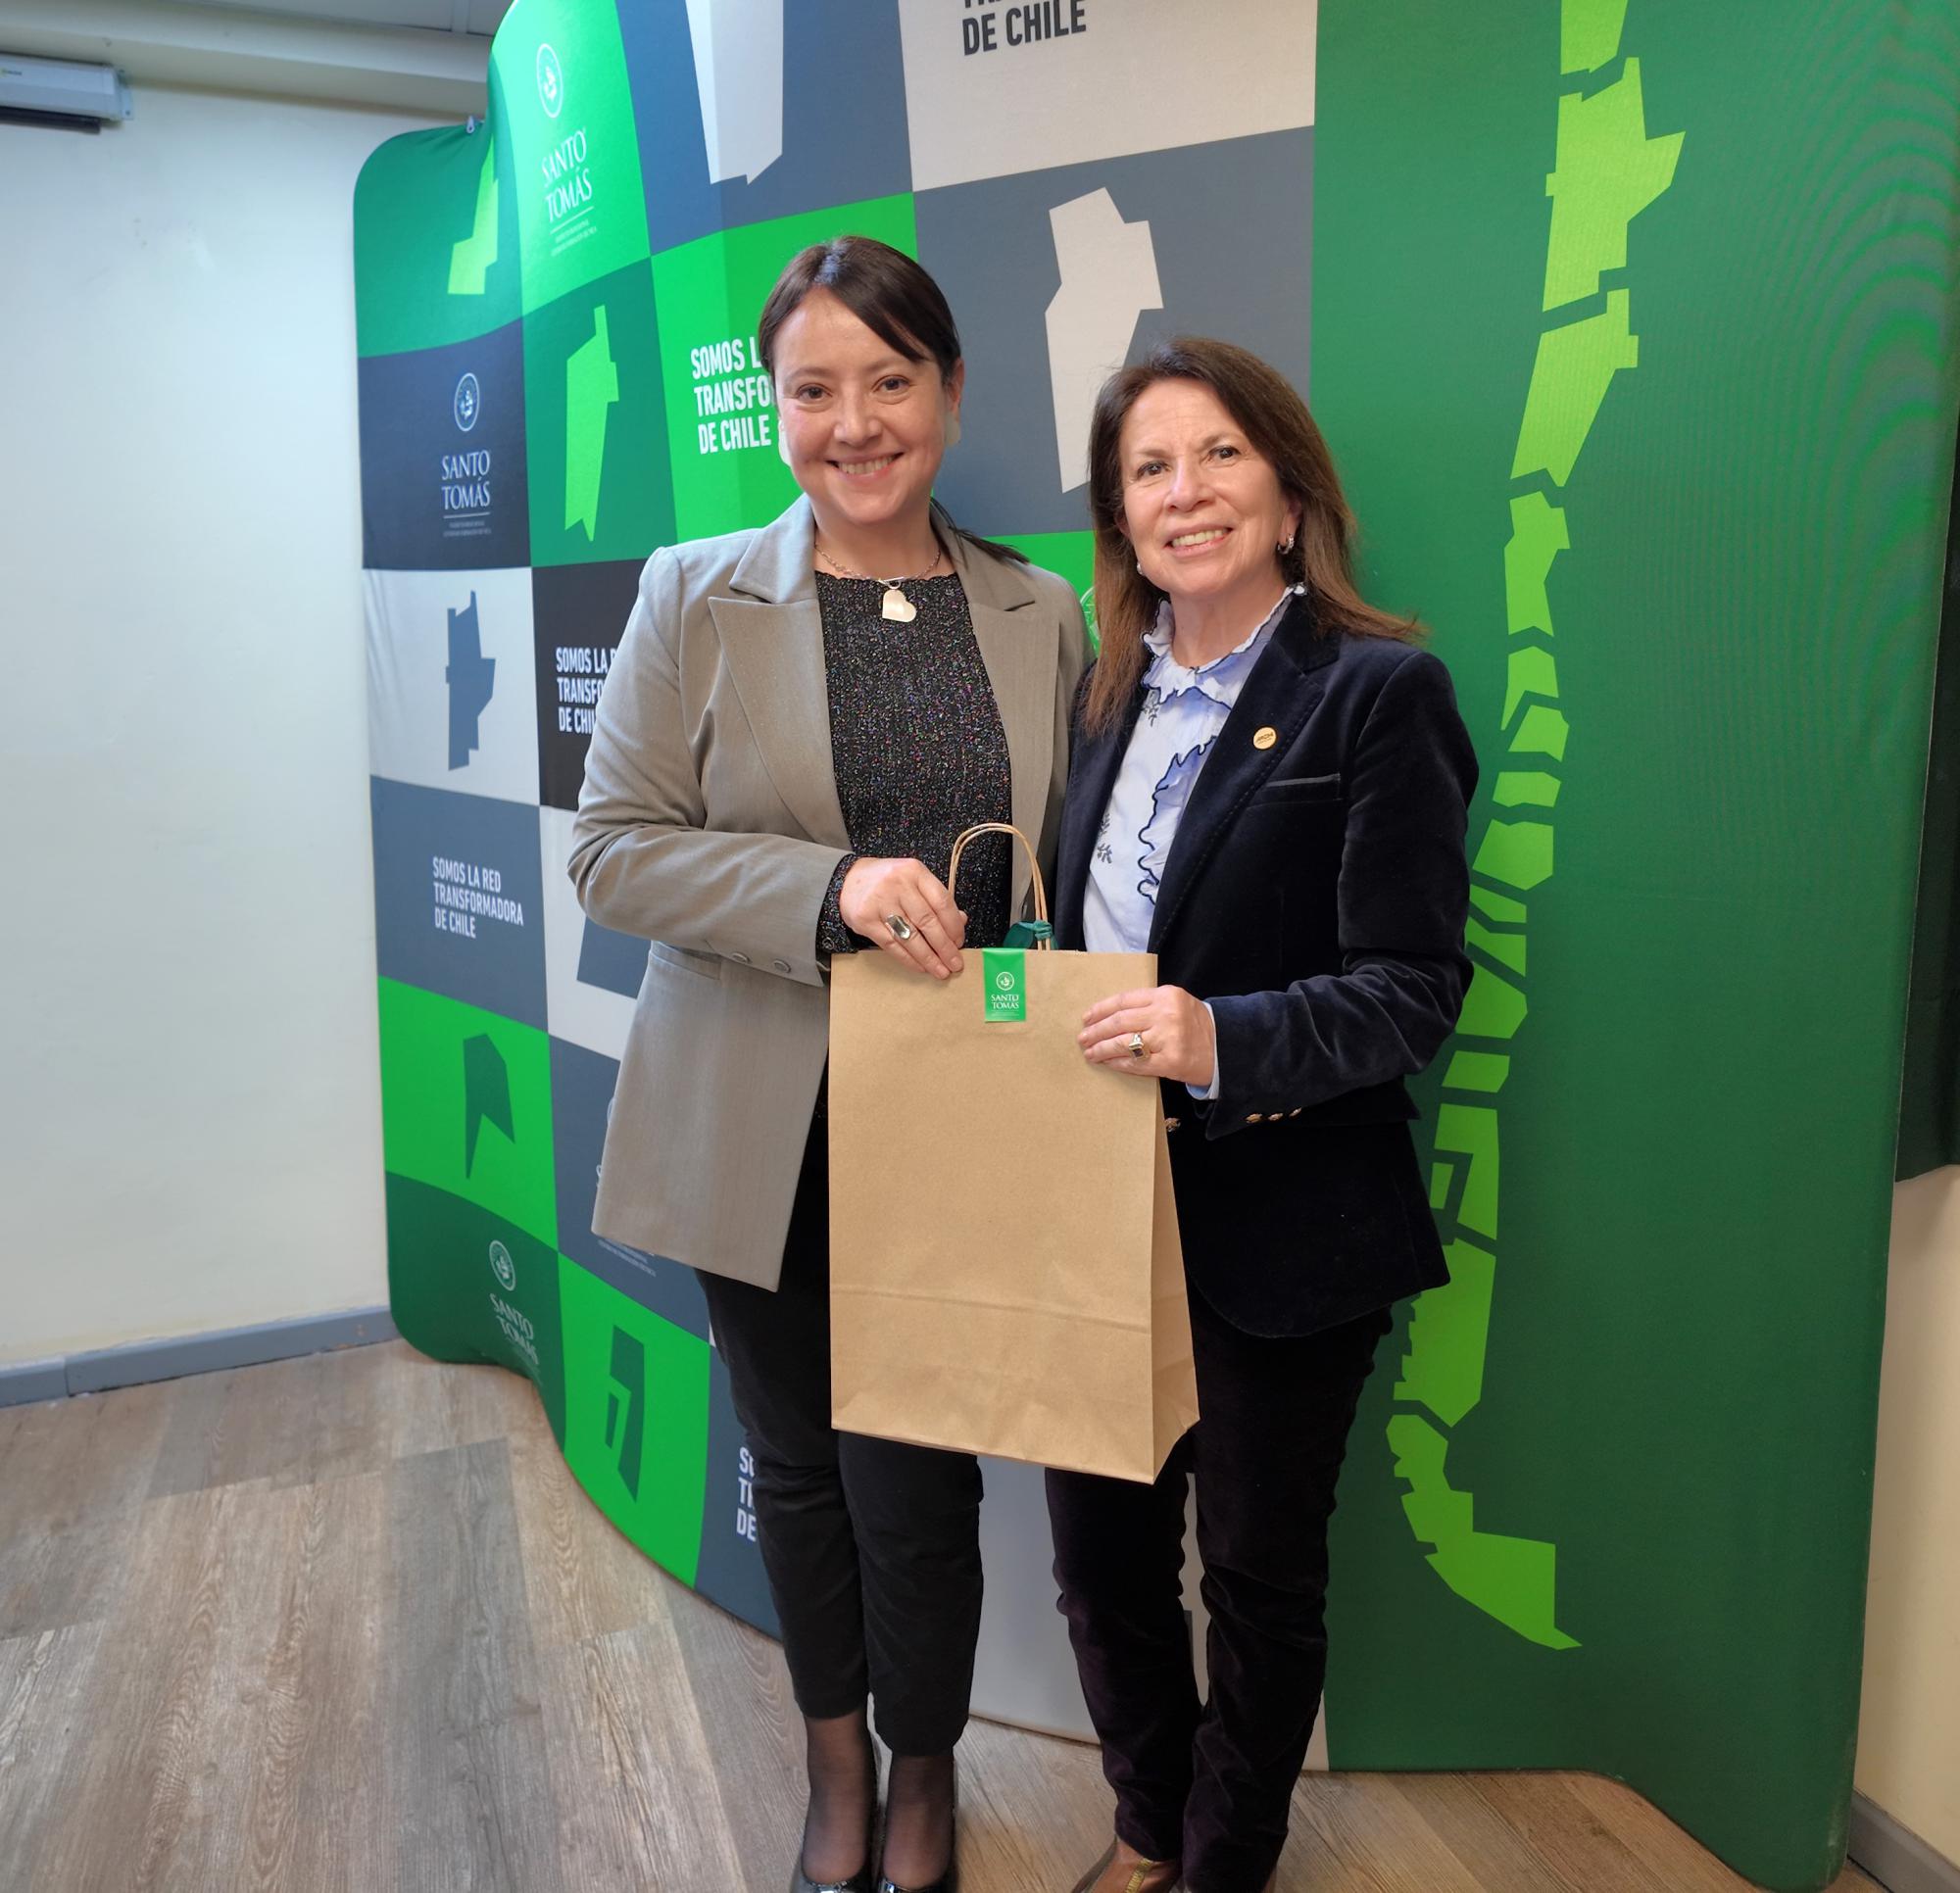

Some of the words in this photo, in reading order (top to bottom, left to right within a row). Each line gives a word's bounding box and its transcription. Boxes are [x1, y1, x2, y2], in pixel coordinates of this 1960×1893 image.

[962, 13, 998, 56] DE
[1005, 0, 1087, 46] CHILE
[541, 129, 587, 187] SANTO
[546, 166, 592, 222] TOMÁS
[690, 338, 745, 380] SOMOS
[749, 336, 762, 368] L
[693, 374, 772, 417] TRANSFO
[697, 421, 718, 455] DE
[720, 413, 772, 452] CHILE
[441, 449, 491, 481] SANTO
[441, 475, 491, 510] TOMÁS
[556, 647, 592, 674] SOMOS
[593, 648, 609, 674] LA
[557, 677, 605, 704] TRANSFO
[558, 705, 573, 733] DE
[574, 707, 596, 735] CHIL
[432, 855, 466, 884] SOMOS
[467, 864, 480, 889] LA
[482, 867, 502, 894] RED
[433, 881, 524, 927] TRANSFORMADORA
[434, 905, 448, 931] DE
[449, 909, 476, 939] CHILE
[990, 994, 1019, 1002] SANTO
[736, 1507, 757, 1542] DE
